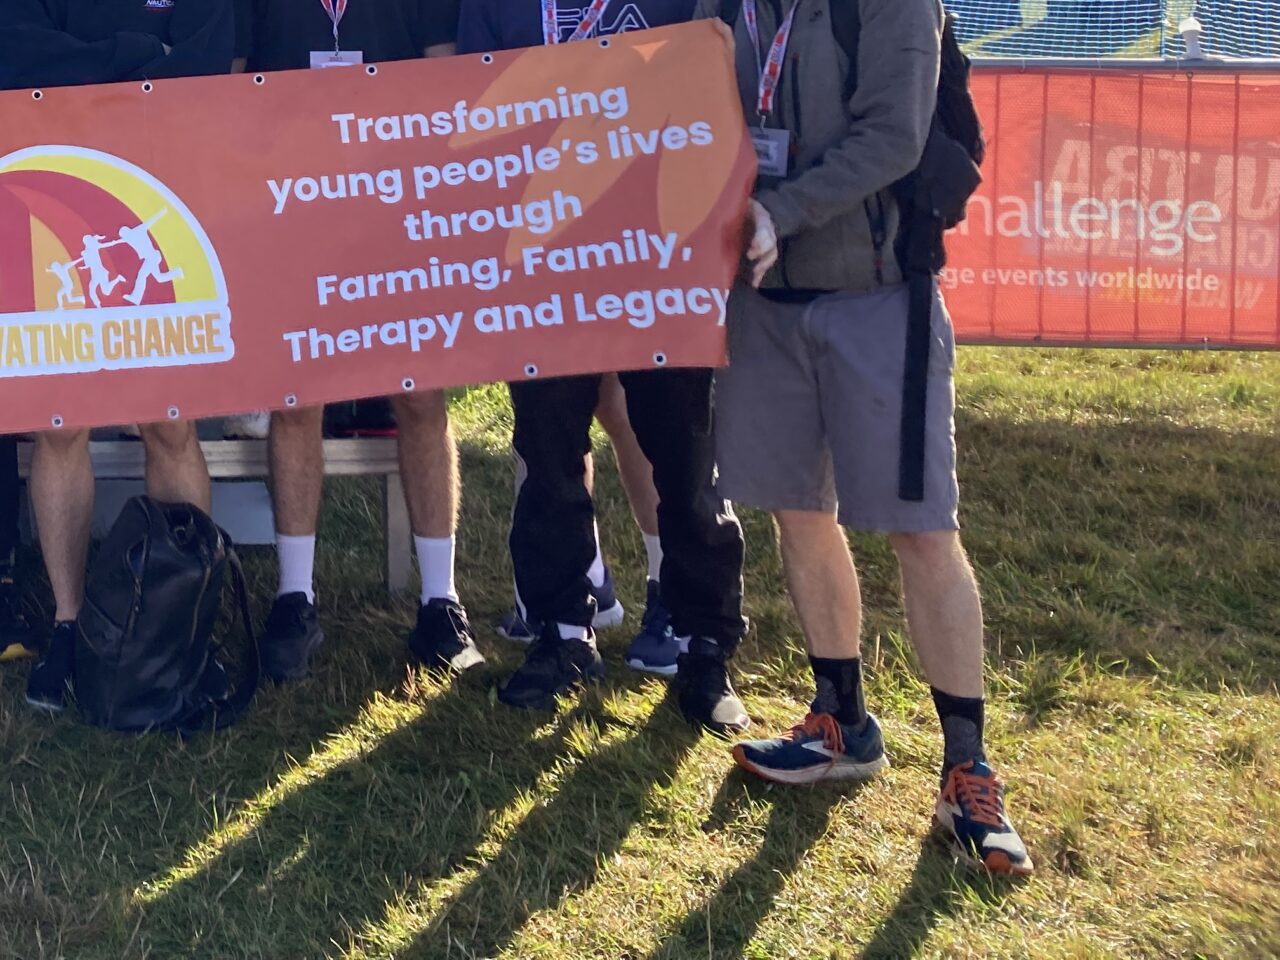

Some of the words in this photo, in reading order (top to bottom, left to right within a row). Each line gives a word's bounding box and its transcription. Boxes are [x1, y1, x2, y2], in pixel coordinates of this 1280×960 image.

[331, 85, 630, 144] Transforming
[267, 167, 404, 215] young
[414, 137, 600, 201] people's
[607, 120, 714, 161] lives
[404, 190, 584, 242] through
[317, 254, 513, 307] Farming,
[523, 229, 693, 278] Family,
[982, 268, 1068, 288] events
[1075, 266, 1221, 291] worldwide
[102, 313, 224, 361] CHANGE
[283, 309, 464, 363] Therapy
[473, 294, 563, 335] and
[573, 286, 729, 331] Legacy
